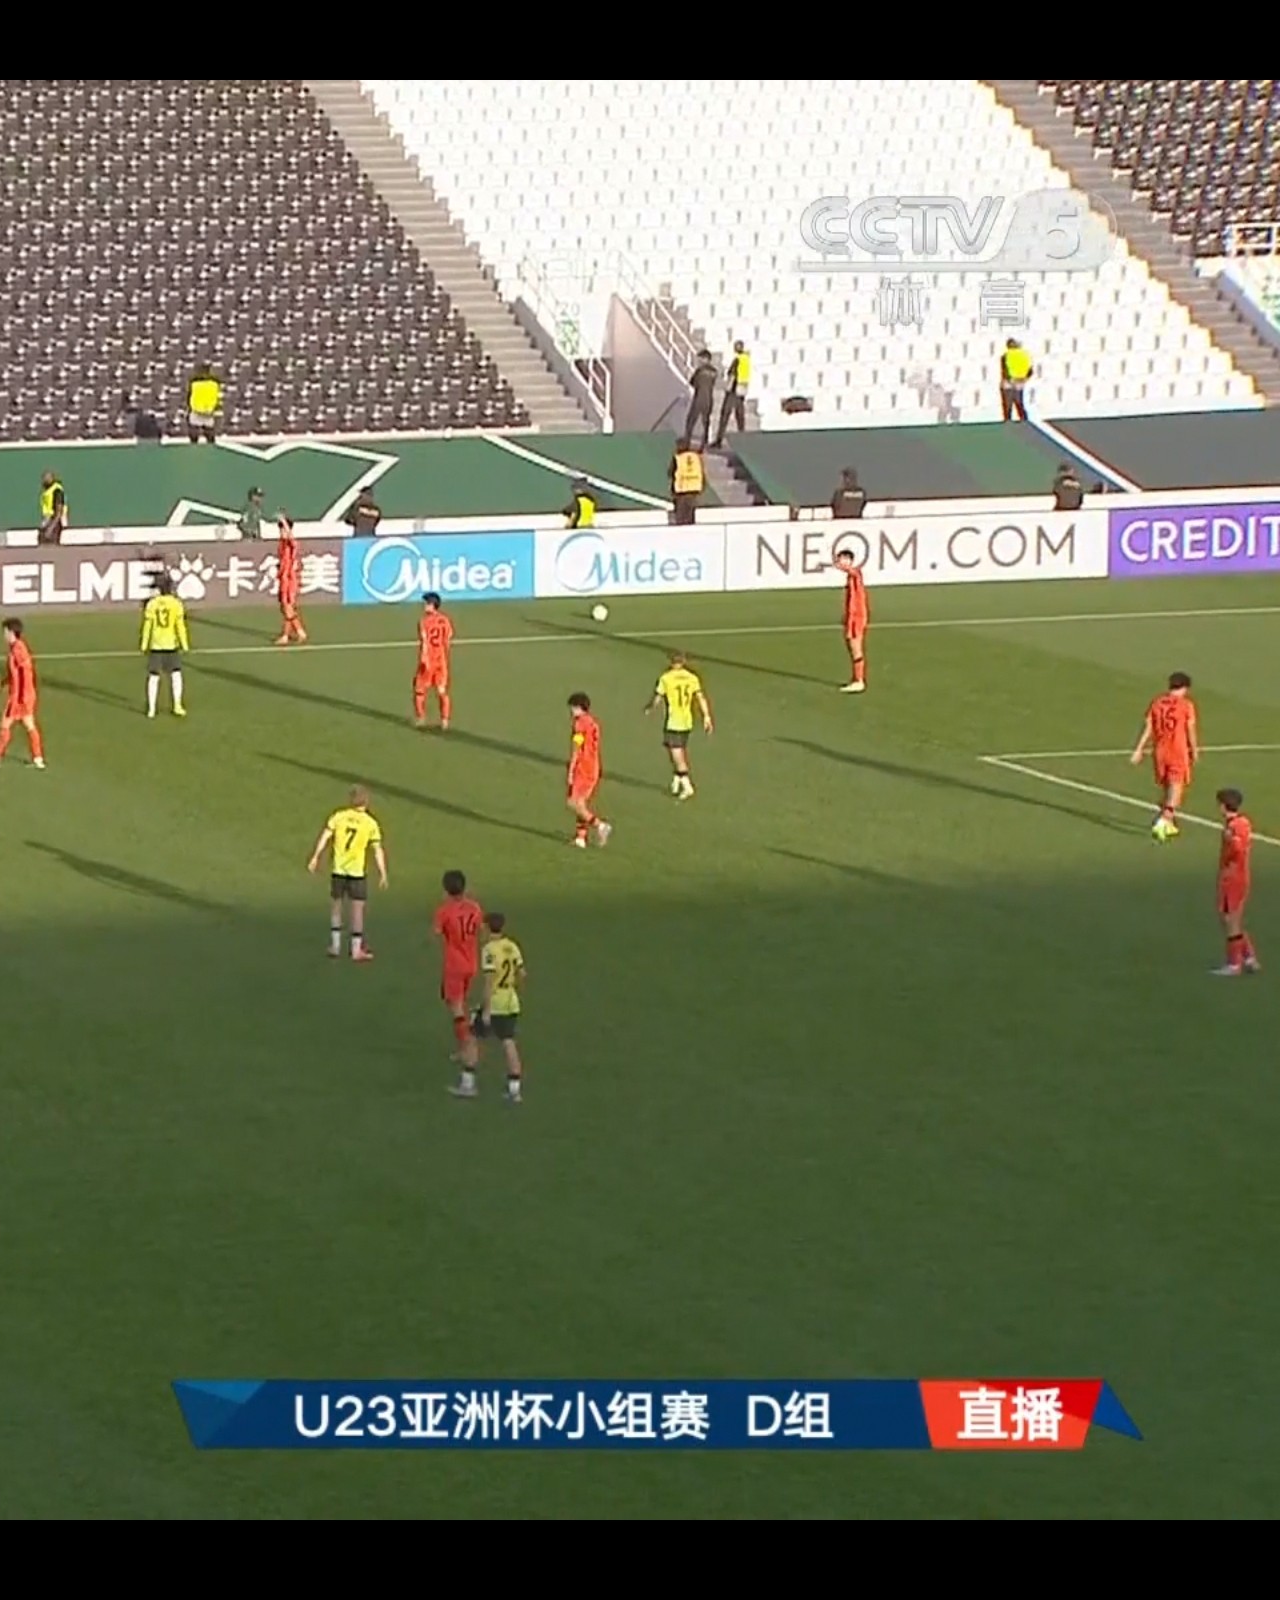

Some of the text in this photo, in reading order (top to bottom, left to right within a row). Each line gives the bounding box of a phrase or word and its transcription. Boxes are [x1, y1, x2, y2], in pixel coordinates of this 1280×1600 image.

[755, 524, 1077, 576] NEOM.COM
[1120, 515, 1280, 563] CREDIT
[386, 556, 515, 595] Midea
[585, 551, 703, 587] Midea
[155, 608, 170, 628] 13
[345, 826, 357, 851] 7
